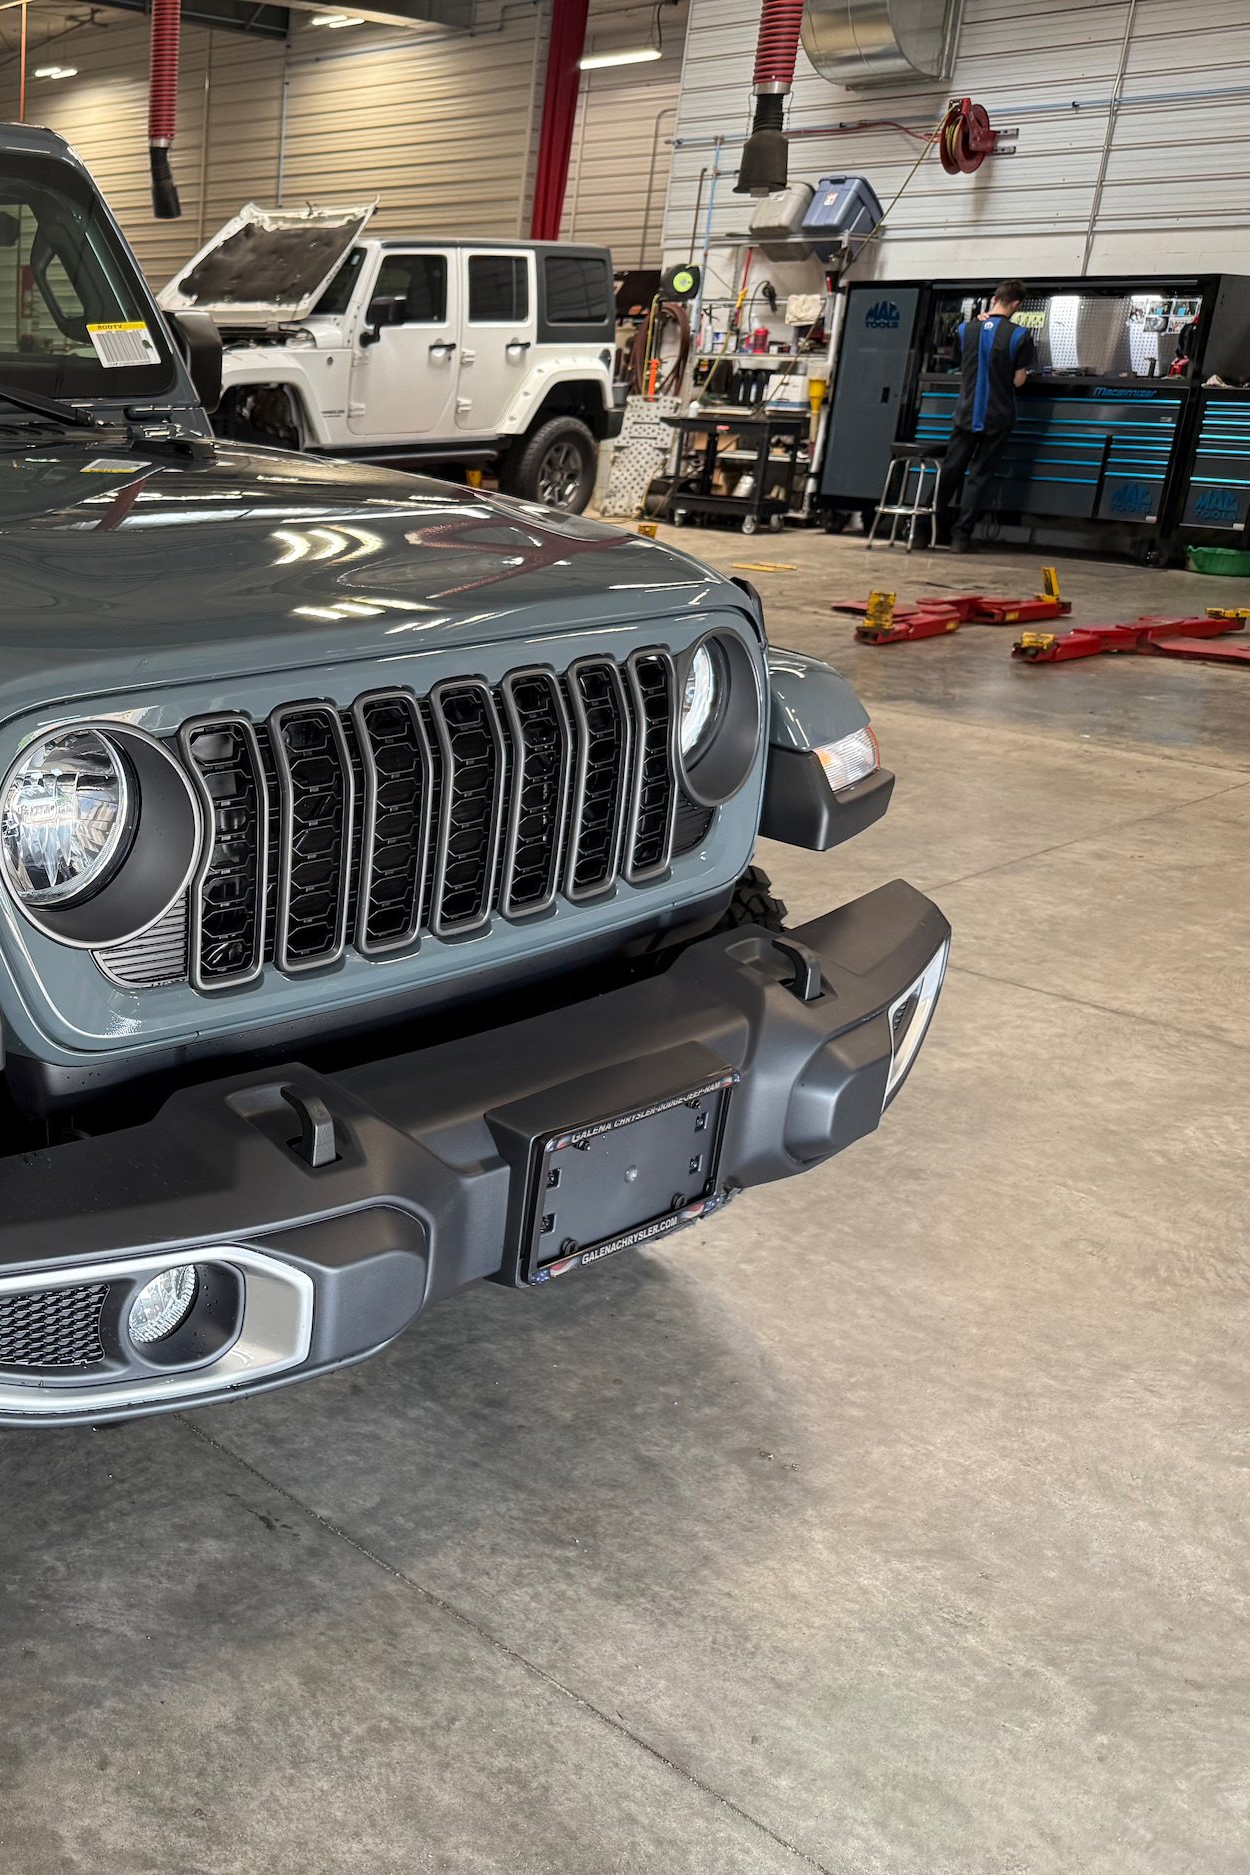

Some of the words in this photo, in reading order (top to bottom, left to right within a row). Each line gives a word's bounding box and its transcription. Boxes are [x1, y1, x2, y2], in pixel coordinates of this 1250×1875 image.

[865, 320, 899, 329] TOOLS
[571, 1122, 612, 1143] GALENA
[581, 1216, 678, 1265] GALENACHRYSLER.COM
